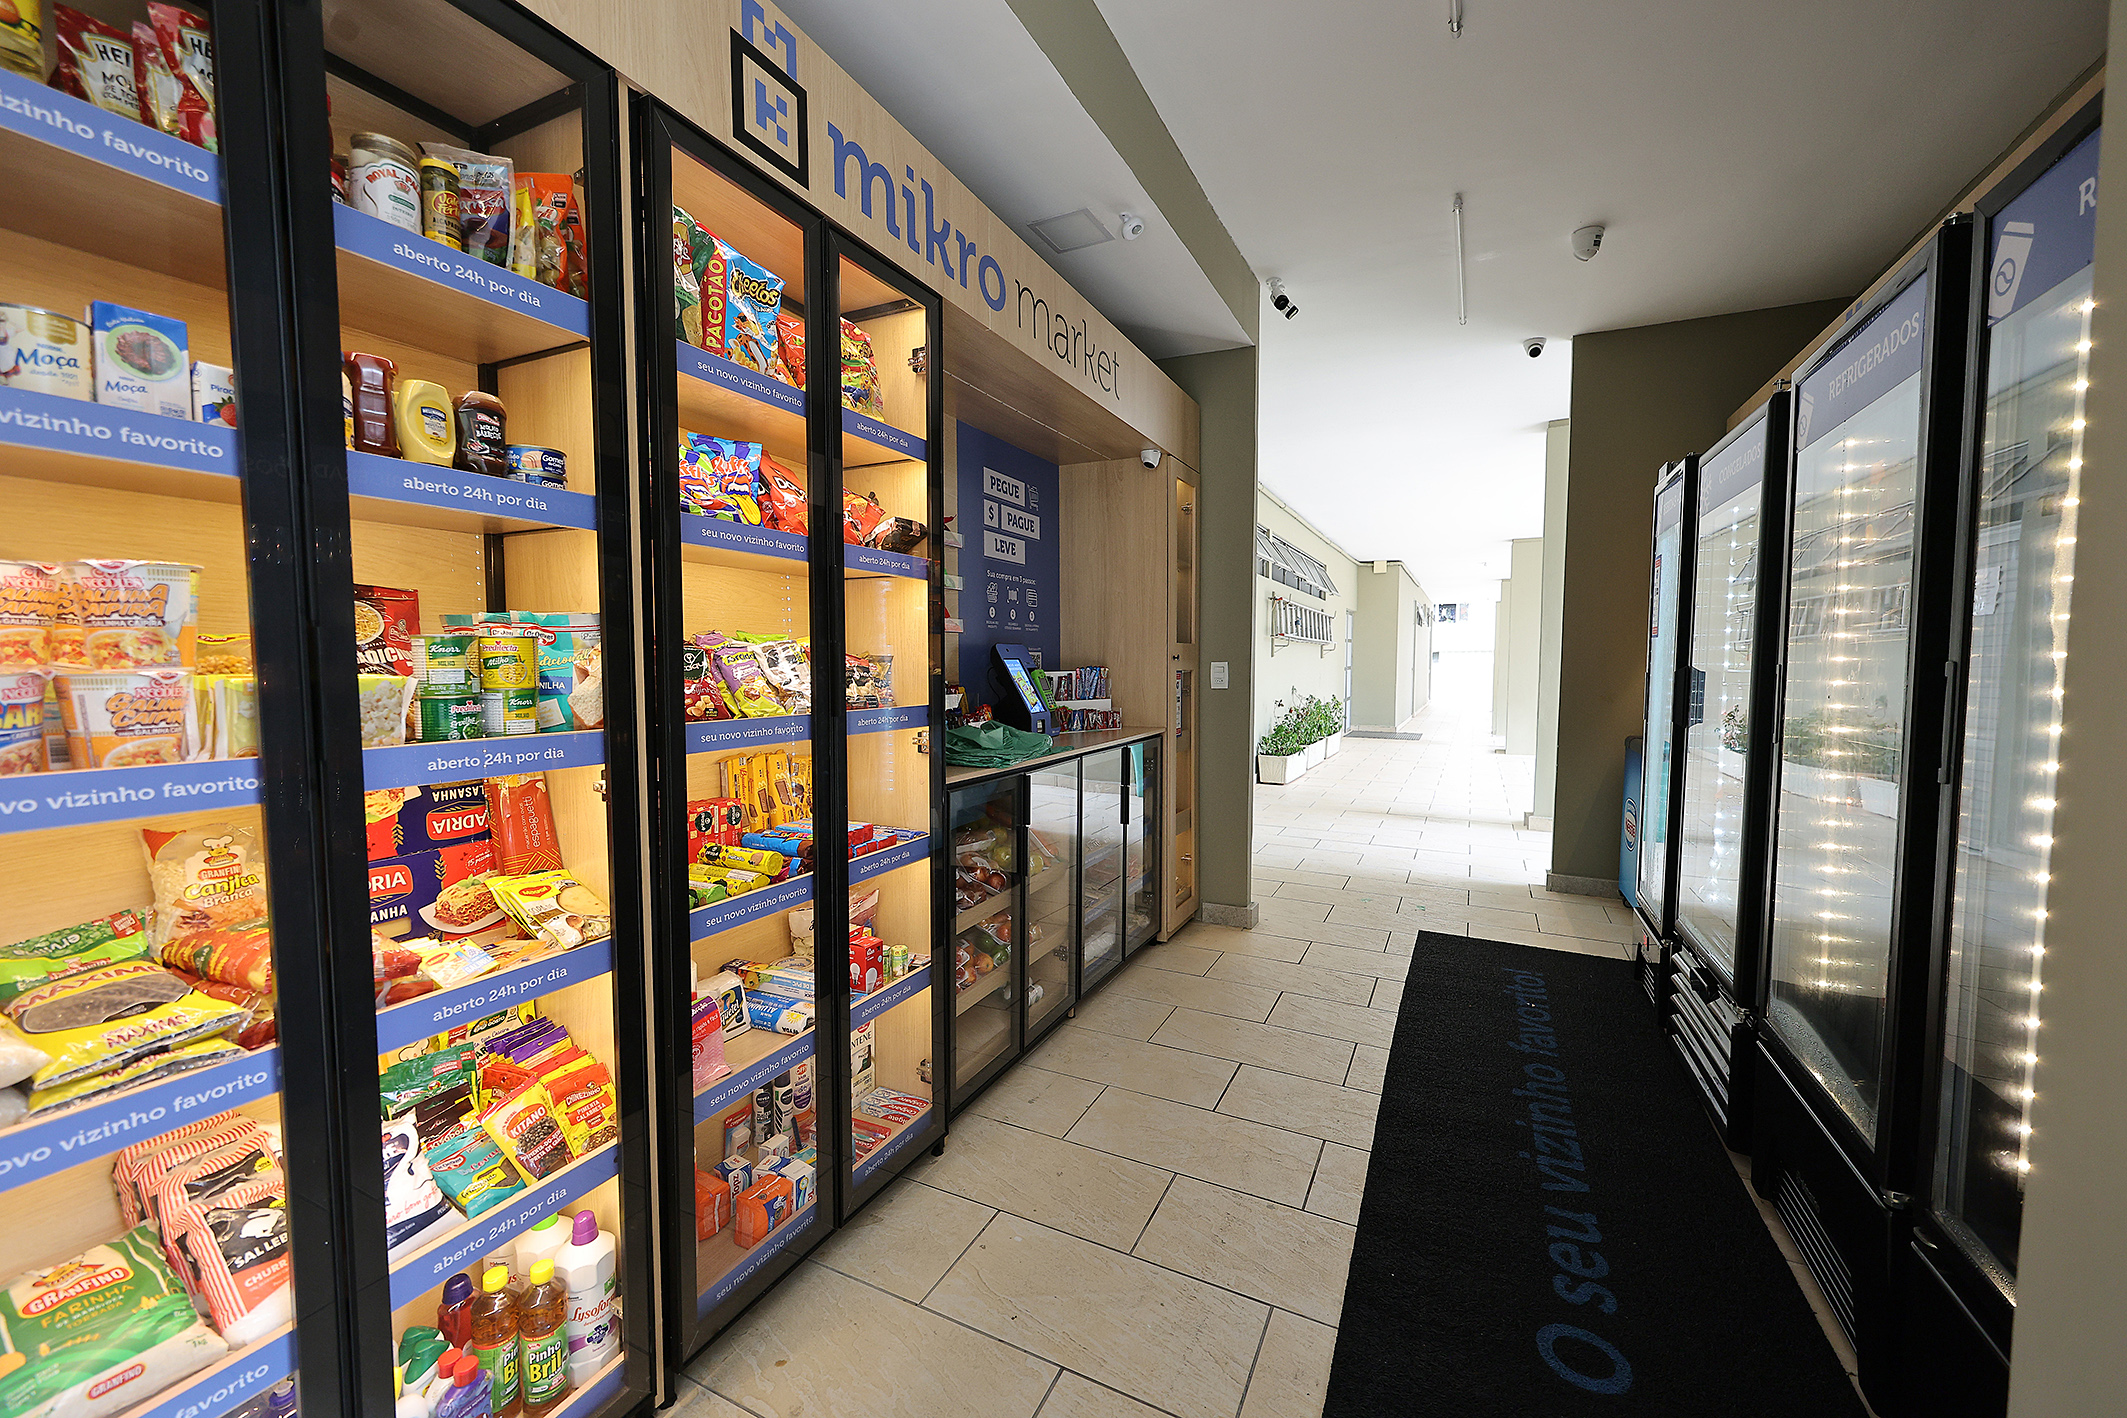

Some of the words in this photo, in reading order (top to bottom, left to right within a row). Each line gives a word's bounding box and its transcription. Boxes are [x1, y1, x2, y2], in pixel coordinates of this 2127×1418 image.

[102, 130, 210, 183] favorito
[366, 168, 401, 184] ROYAL
[2078, 176, 2097, 217] R
[393, 242, 451, 273] aberto
[455, 264, 485, 288] 24h
[488, 279, 515, 297] por
[519, 290, 542, 308] dia
[827, 120, 1007, 312] mikro
[1014, 278, 1121, 401] market
[703, 258, 725, 349] PACOTÃO
[730, 268, 779, 307] Cheetos
[15, 347, 80, 370] Moça
[1828, 310, 1921, 401] REFRIGERADOS
[104, 380, 149, 395] Moça
[697, 360, 715, 374] seu
[716, 367, 740, 383] novo
[740, 374, 772, 396] vizinho
[772, 387, 803, 408] favorito
[0, 408, 112, 440] vizinho
[119, 427, 225, 459] favorito
[857, 421, 877, 436] aberto
[877, 427, 888, 439] 24h
[888, 433, 900, 443] por
[899, 437, 909, 448] dia
[542, 454, 565, 465] Gomes
[1718, 443, 1762, 484] CONGELADOS
[403, 476, 459, 497] aberto
[463, 485, 494, 502] 24h
[497, 491, 523, 507] por
[526, 496, 548, 512] dia
[990, 475, 1020, 499] PEGUE
[1007, 512, 1035, 533] PAGUE
[701, 527, 719, 538] seu
[719, 531, 743, 543] novo
[743, 533, 775, 548] vizinho
[775, 539, 805, 554] favorito
[994, 537, 1017, 556] LEVE
[858, 553, 878, 565] aberto
[878, 557, 890, 568] 24h
[890, 560, 901, 570] por
[901, 561, 911, 571] dia
[986, 569, 998, 579] Sua
[998, 573, 1012, 582] compra
[428, 644, 461, 653] Knorr
[486, 656, 509, 667] Milho
[508, 698, 534, 706] Knorr
[700, 732, 717, 743] seu
[718, 730, 741, 742] novo
[742, 725, 773, 739] vizinho
[774, 723, 804, 736] favorito
[857, 717, 877, 727] aberto
[877, 716, 889, 724] 24h
[889, 715, 900, 725] por
[900, 713, 909, 722] dia
[427, 755, 480, 772] aberto
[485, 751, 513, 766] 24h
[516, 750, 541, 763] por
[544, 747, 565, 760] dia
[46, 785, 156, 811] vizinho
[162, 776, 260, 798] favorito
[431, 812, 487, 835] ADRIA
[522, 795, 541, 848] espaguetti
[859, 862, 880, 874] aberto
[880, 857, 891, 867] 24h
[891, 853, 902, 865] por
[901, 848, 911, 859] dia
[184, 873, 260, 900] Canjica
[203, 888, 255, 909] Branca
[705, 916, 722, 928] seu
[723, 907, 746, 920] novo
[747, 896, 778, 914] vizinho
[778, 886, 808, 903] favorito
[432, 995, 486, 1023] aberto
[489, 984, 517, 1003] 24h
[519, 975, 544, 993] por
[547, 965, 568, 982] dia
[861, 1003, 881, 1018] aberto
[881, 996, 892, 1007] 24h
[892, 989, 903, 1002] por
[902, 984, 912, 995] dia
[710, 1092, 727, 1108] seu
[728, 1078, 750, 1097] novo
[750, 1059, 781, 1084] vizinho
[781, 1043, 810, 1066] favorito
[59, 1106, 167, 1153] vizinho
[173, 1069, 269, 1113] favorito
[565, 1086, 601, 1106] CHINEZINHO
[576, 1099, 600, 1115] PIMENTA
[510, 1105, 546, 1138] KITANO
[1512, 1061, 1591, 1194] vizinho
[864, 1156, 884, 1177] aberto
[884, 1147, 895, 1160] 24h
[894, 1139, 905, 1152] por
[904, 1131, 914, 1143] dia
[432, 1236, 486, 1275] aberto
[489, 1217, 517, 1241] 24h
[519, 1201, 545, 1225] por
[546, 1187, 568, 1206] dia
[234, 1246, 265, 1269] SAL
[243, 1258, 289, 1288] CHURR
[715, 1284, 732, 1302] seu
[733, 1264, 755, 1286] novo
[755, 1240, 785, 1267] vizinho
[785, 1214, 814, 1242] favorito
[1544, 1205, 1618, 1315] seu
[29, 1268, 125, 1314] GRANFINO
[41, 1284, 135, 1328] FARINHA
[529, 1340, 562, 1364] Pinho
[529, 1348, 564, 1383] Bril
[1536, 1322, 1634, 1396] O
[89, 1365, 144, 1399] GRANFINO
[175, 1364, 270, 1418] favorito
